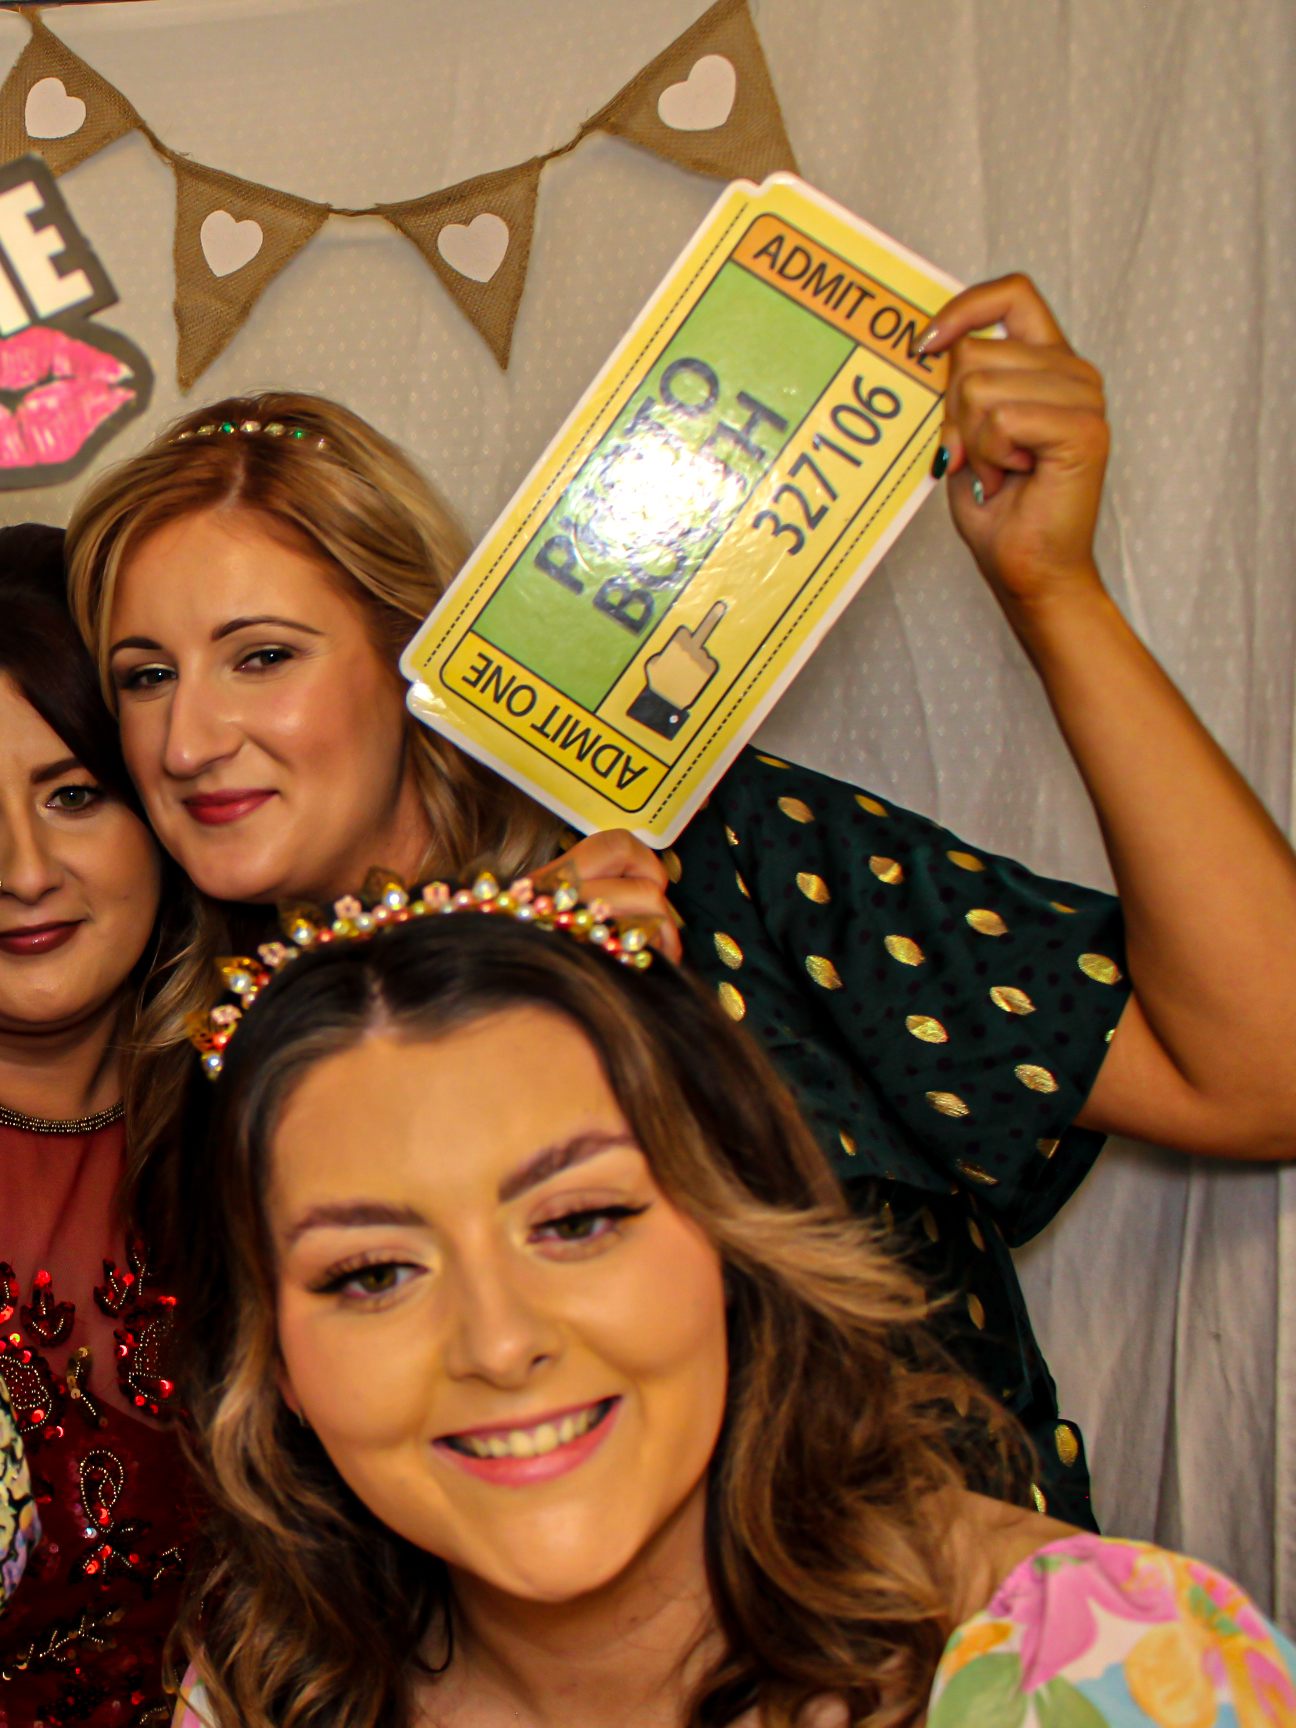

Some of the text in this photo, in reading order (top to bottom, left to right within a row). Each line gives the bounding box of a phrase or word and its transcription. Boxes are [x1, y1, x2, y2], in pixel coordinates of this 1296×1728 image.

[752, 234, 876, 320] ADMIT
[752, 374, 902, 556] 327106
[461, 651, 649, 790] ADMIT ONE
